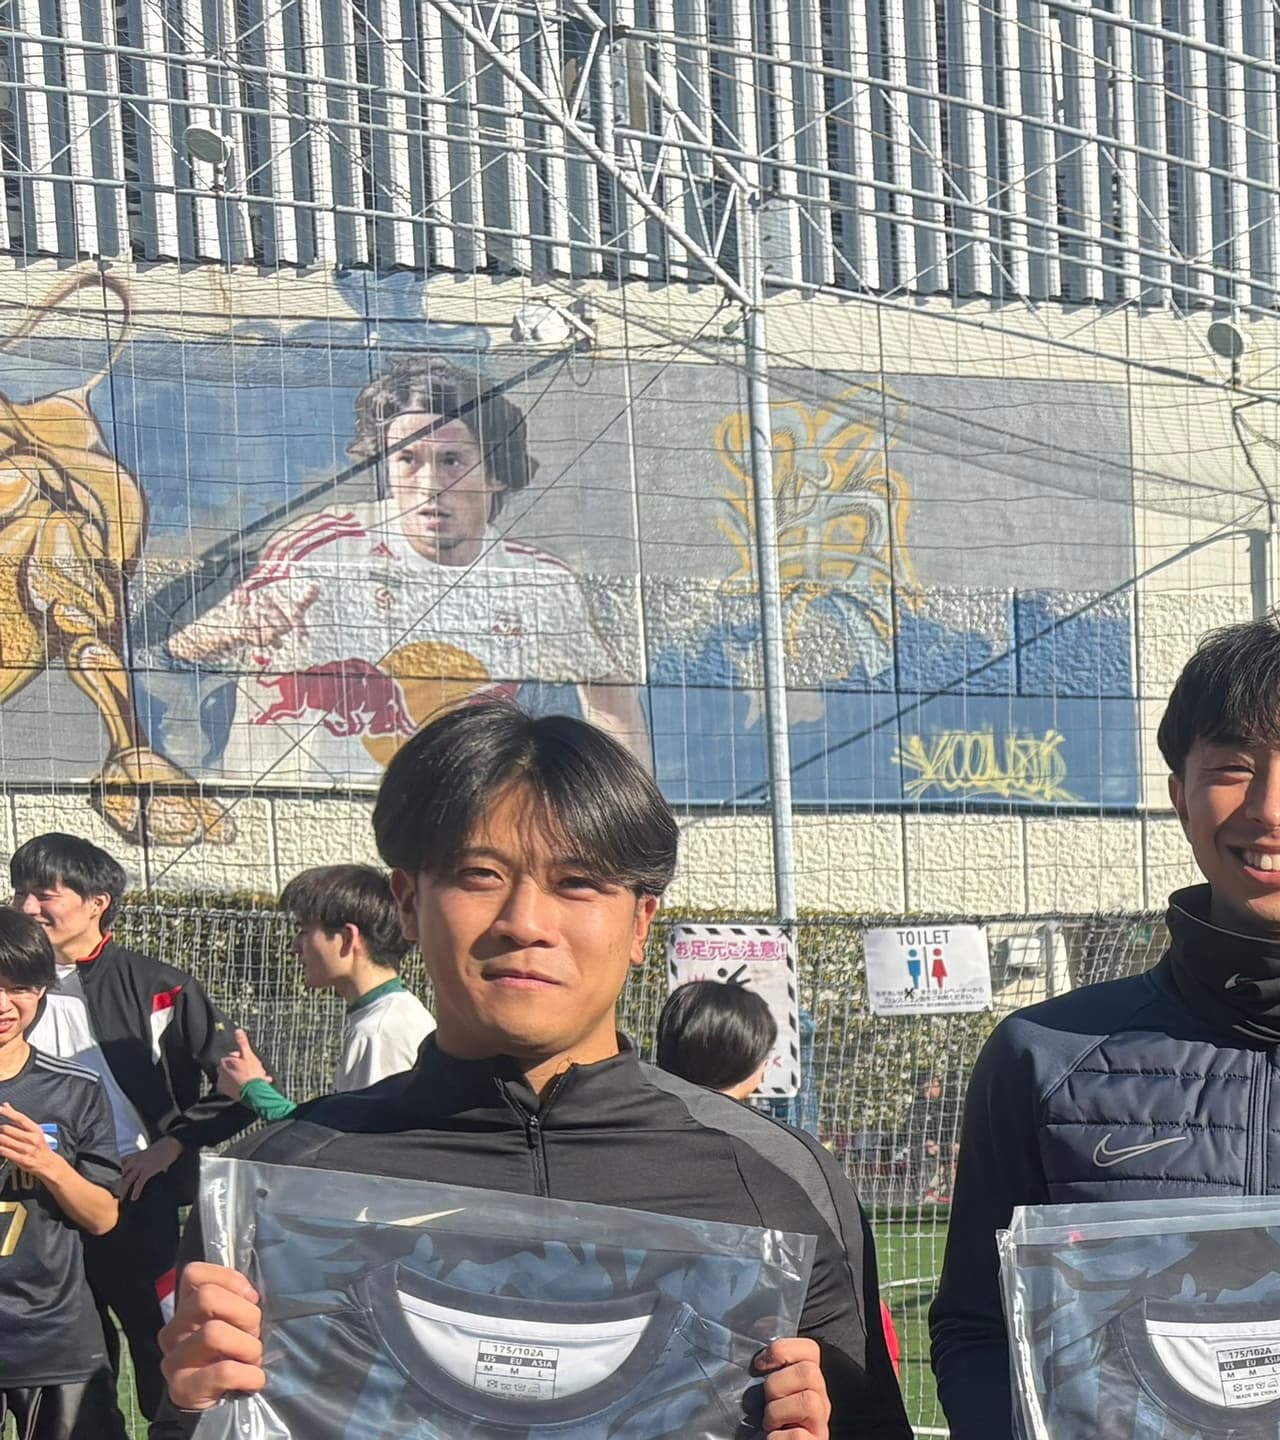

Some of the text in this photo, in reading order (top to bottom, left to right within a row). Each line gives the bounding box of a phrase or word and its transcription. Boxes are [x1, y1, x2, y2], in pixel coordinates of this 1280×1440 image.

[897, 930, 951, 945] TOILET
[493, 1345, 544, 1357] 175/102A
[1229, 1347, 1273, 1359] 175/102A
[531, 1360, 553, 1368] ASIA
[1246, 1359, 1257, 1367] EU
[484, 1364, 493, 1372] M
[510, 1367, 520, 1375] M
